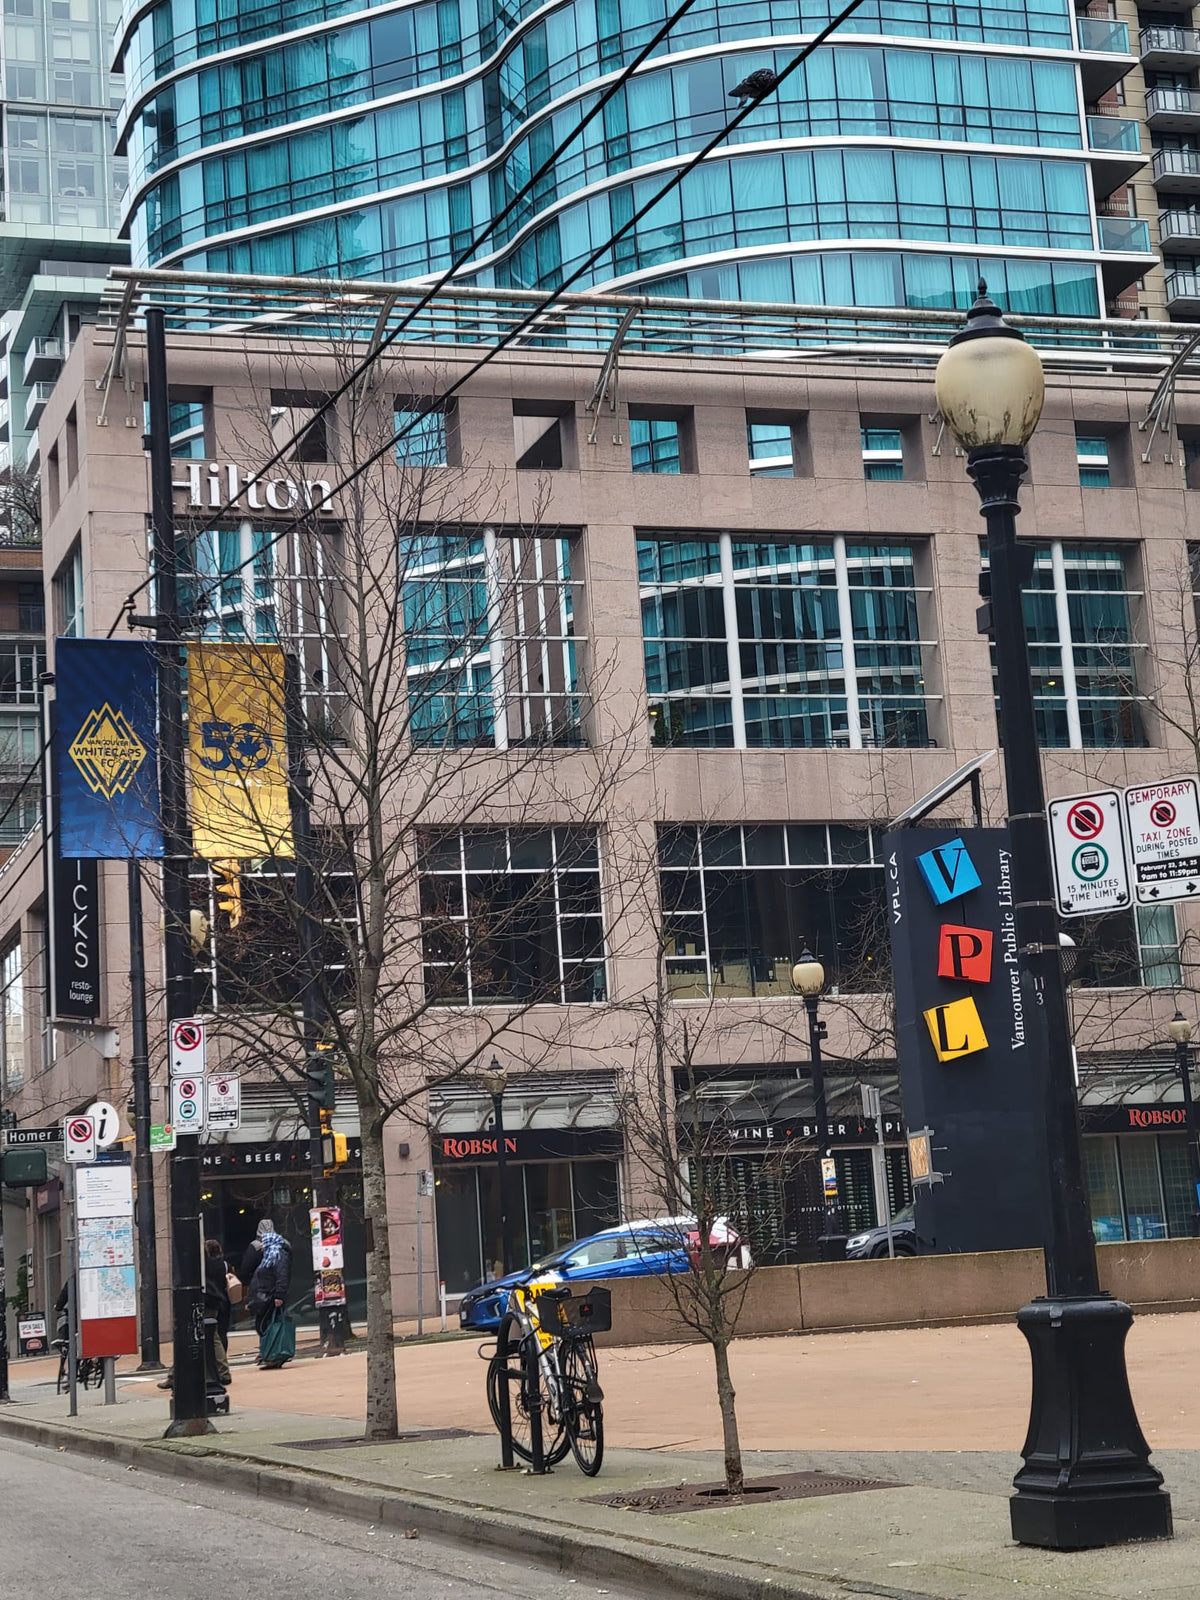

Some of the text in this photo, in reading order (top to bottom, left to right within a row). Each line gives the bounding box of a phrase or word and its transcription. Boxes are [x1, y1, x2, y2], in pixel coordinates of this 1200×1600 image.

[172, 462, 334, 512] Hilton
[87, 739, 129, 747] VANCOUVER
[201, 721, 274, 772] 50
[73, 747, 142, 757] WHITECAPS
[101, 759, 115, 768] FC
[1129, 783, 1191, 804] TEMPORARY
[1140, 826, 1192, 843] TAXI ZONE
[1136, 836, 1198, 853] DURING POSTED
[1157, 849, 1180, 859] TIMES
[1140, 864, 1166, 872] February
[1141, 867, 1198, 881] 9am to 11:59pm
[888, 852, 902, 924] VPL.CA
[1067, 879, 1119, 893] 15 MINUTES
[1070, 888, 1118, 902] TIME LIMIT
[998, 848, 1025, 1050] Vancouver Public Library
[69, 989, 93, 1004] lounge
[9, 1131, 52, 1142] Homer
[728, 1127, 774, 1140] WINE
[245, 1153, 281, 1163] BEER
